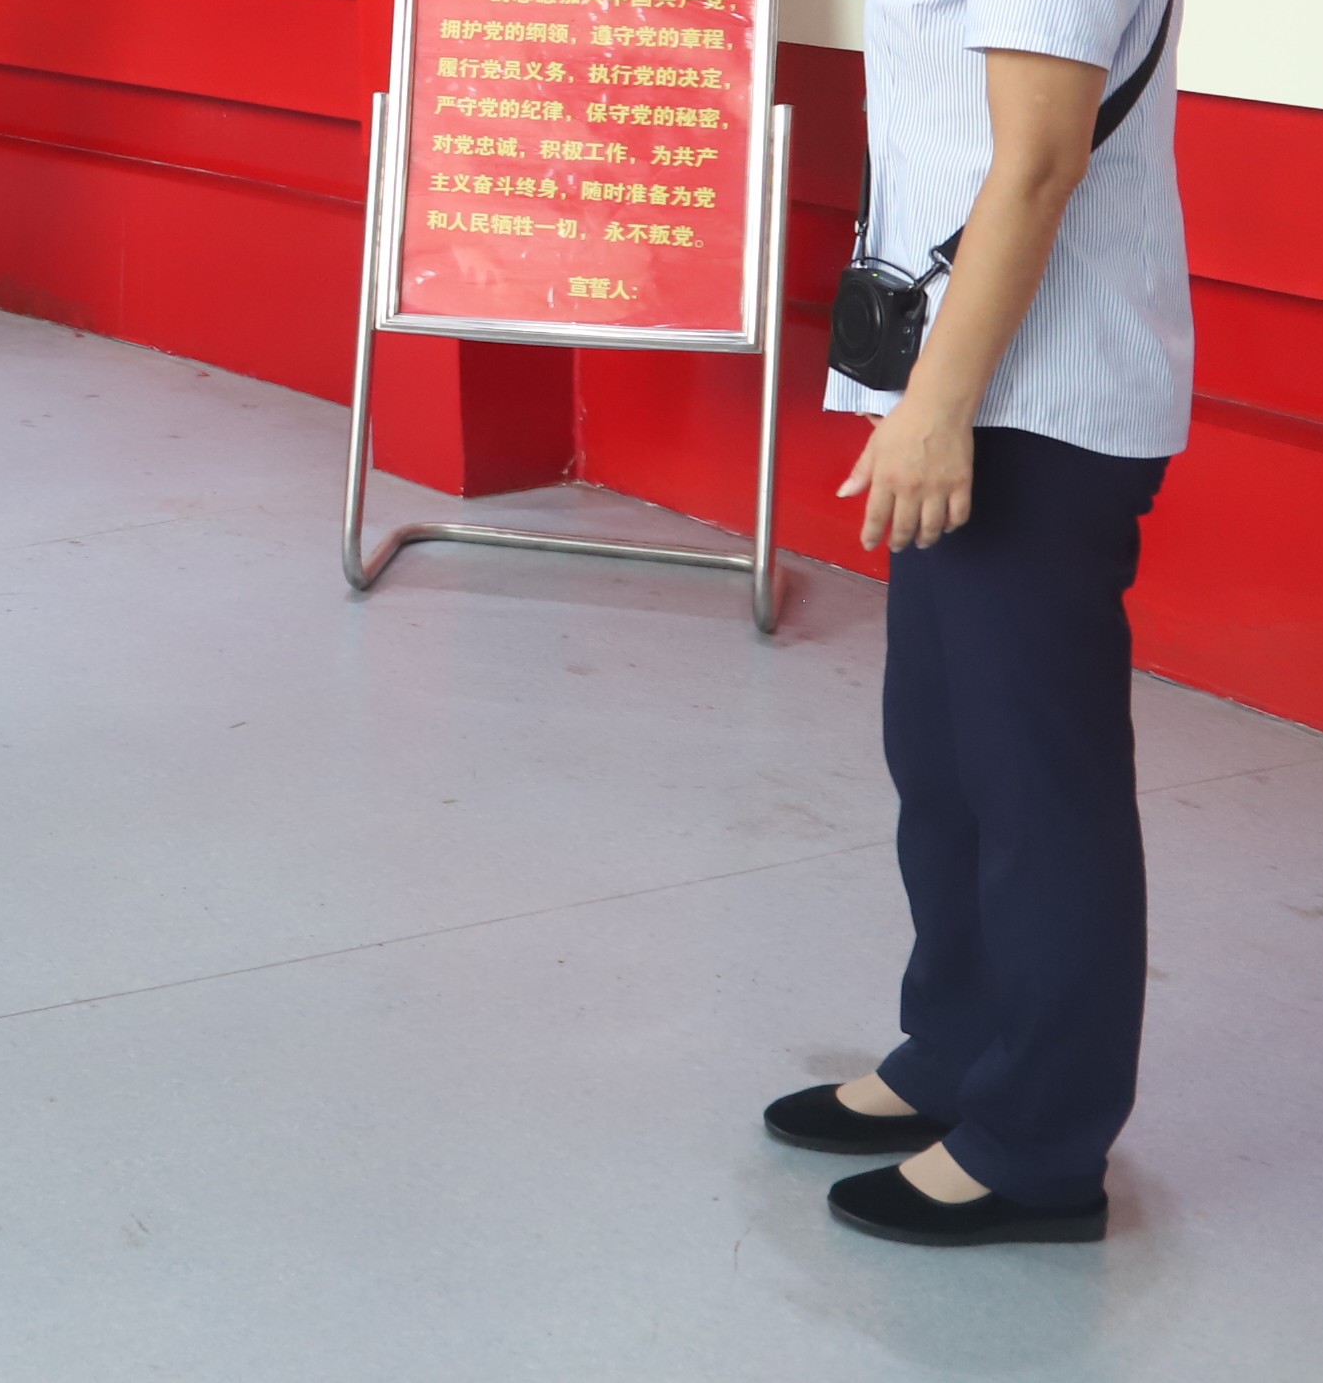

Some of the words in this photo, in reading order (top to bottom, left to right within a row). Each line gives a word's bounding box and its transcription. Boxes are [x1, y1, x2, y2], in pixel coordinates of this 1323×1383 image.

[439, 19, 733, 51] 拥护党的纲领，遵守党的章程，
[437, 57, 731, 90] 履行党员义务，执行党的决定，
[434, 95, 730, 130] 严守党的纪律，保守党的秘密，
[431, 134, 718, 168] 对党忠诚，积极工作，为共产
[429, 173, 716, 209] 主义奋斗终身，随时准备为党
[426, 210, 704, 248] 和人民牺牲一切，永不叛党。
